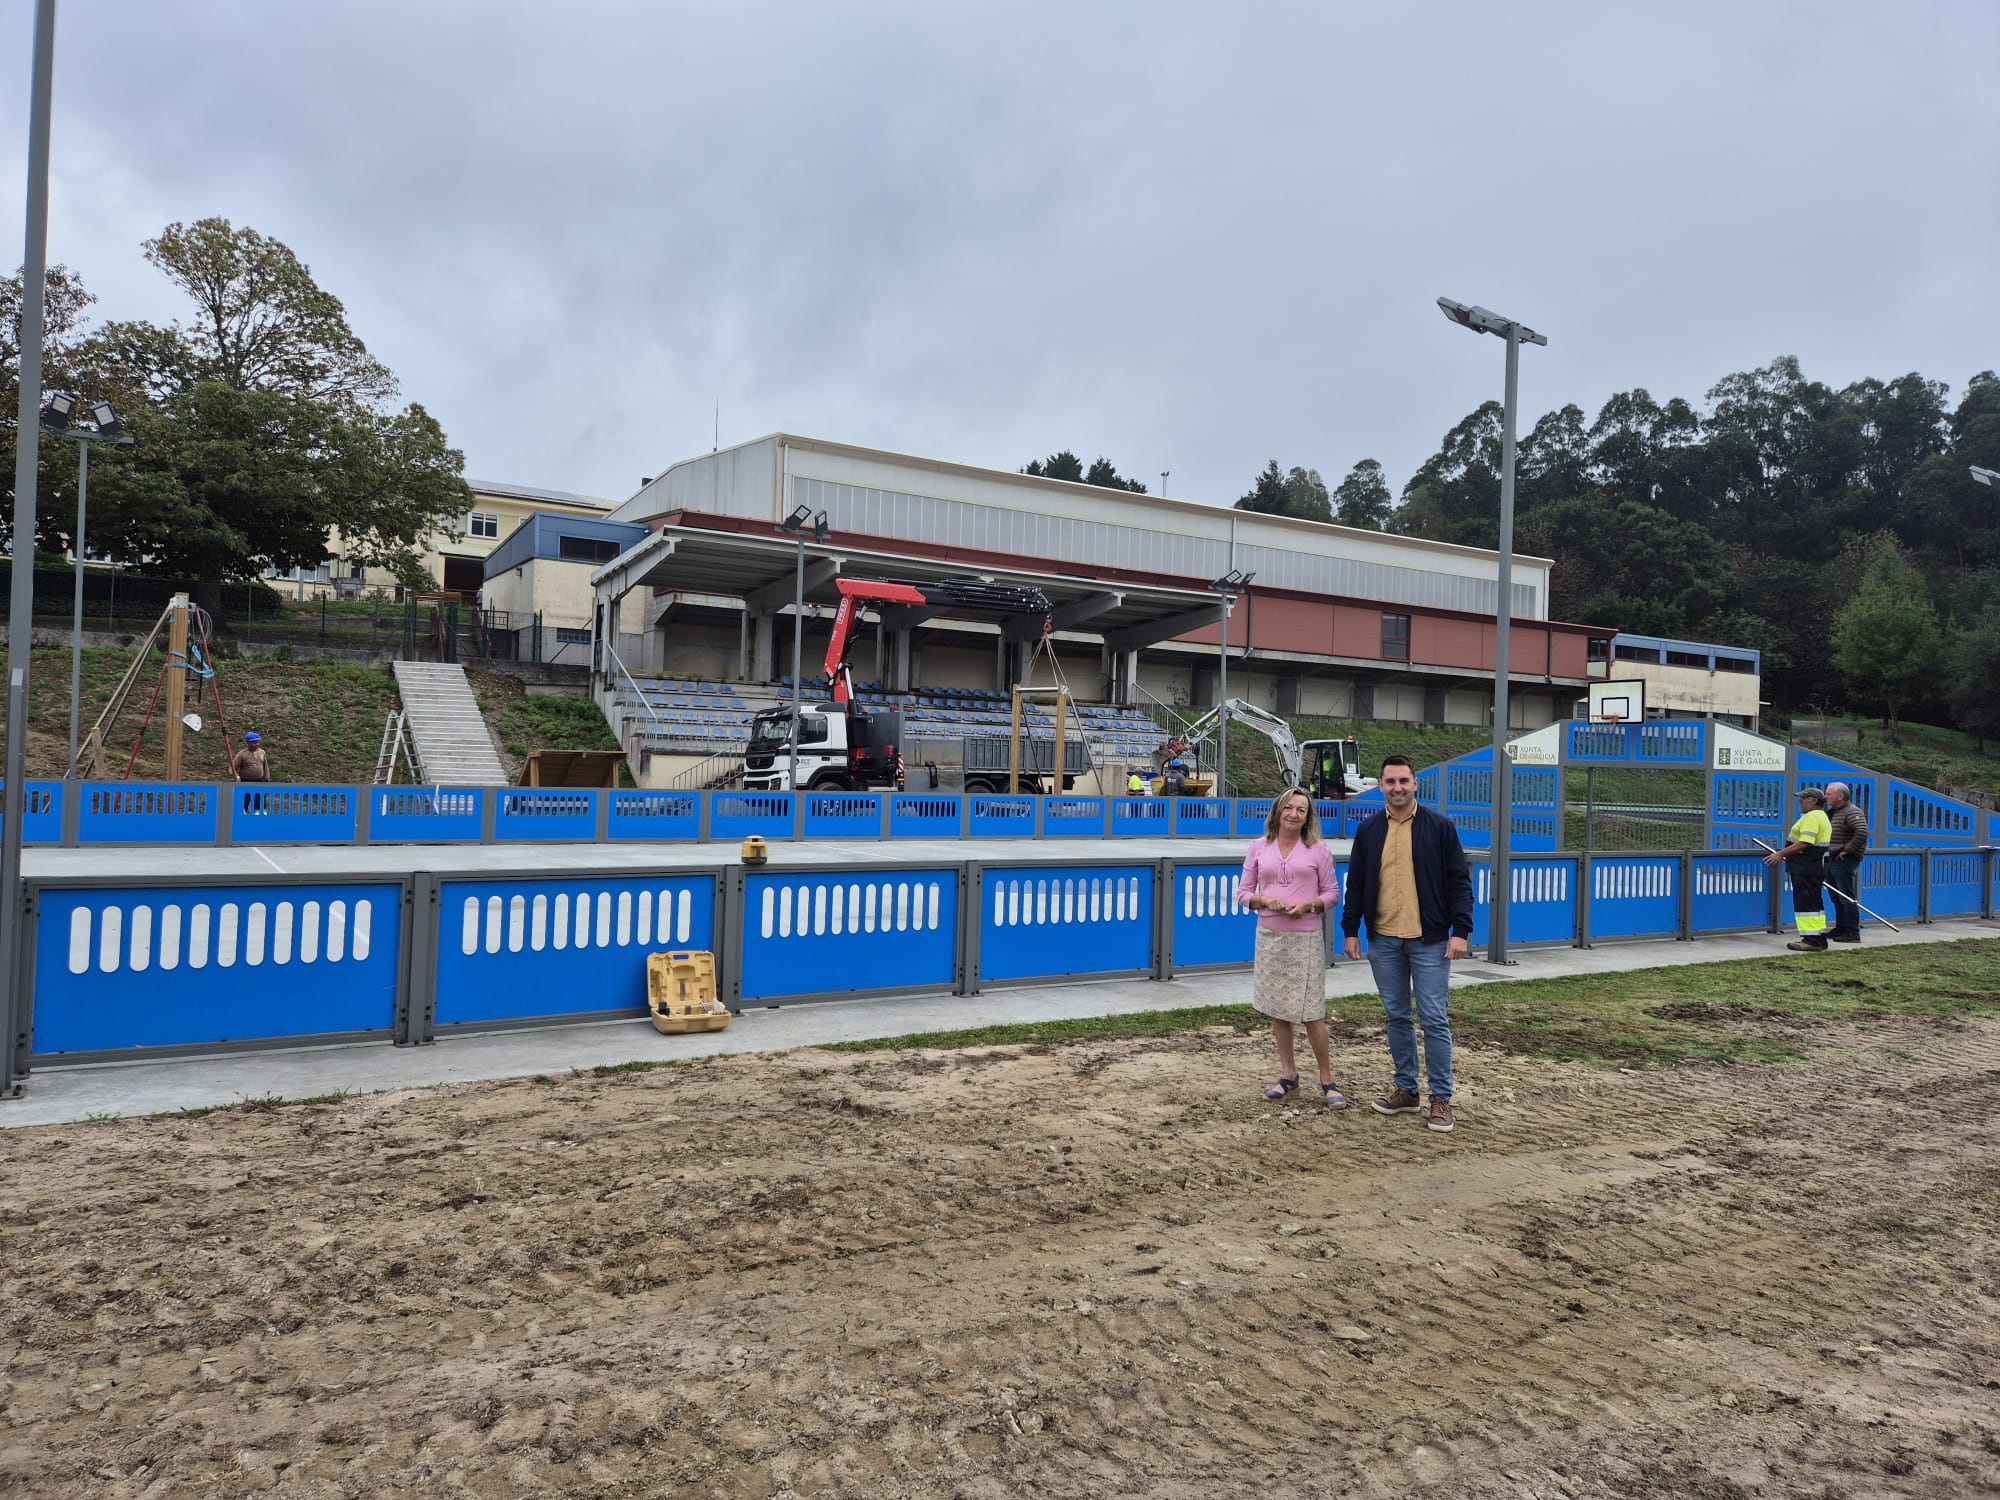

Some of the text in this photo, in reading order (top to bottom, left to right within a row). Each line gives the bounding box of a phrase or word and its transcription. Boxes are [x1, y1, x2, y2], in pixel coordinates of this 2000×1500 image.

[1530, 753, 1556, 761] GALICIA
[1734, 749, 1762, 757] XUNTA
[1733, 757, 1781, 765] DE GALICIA
